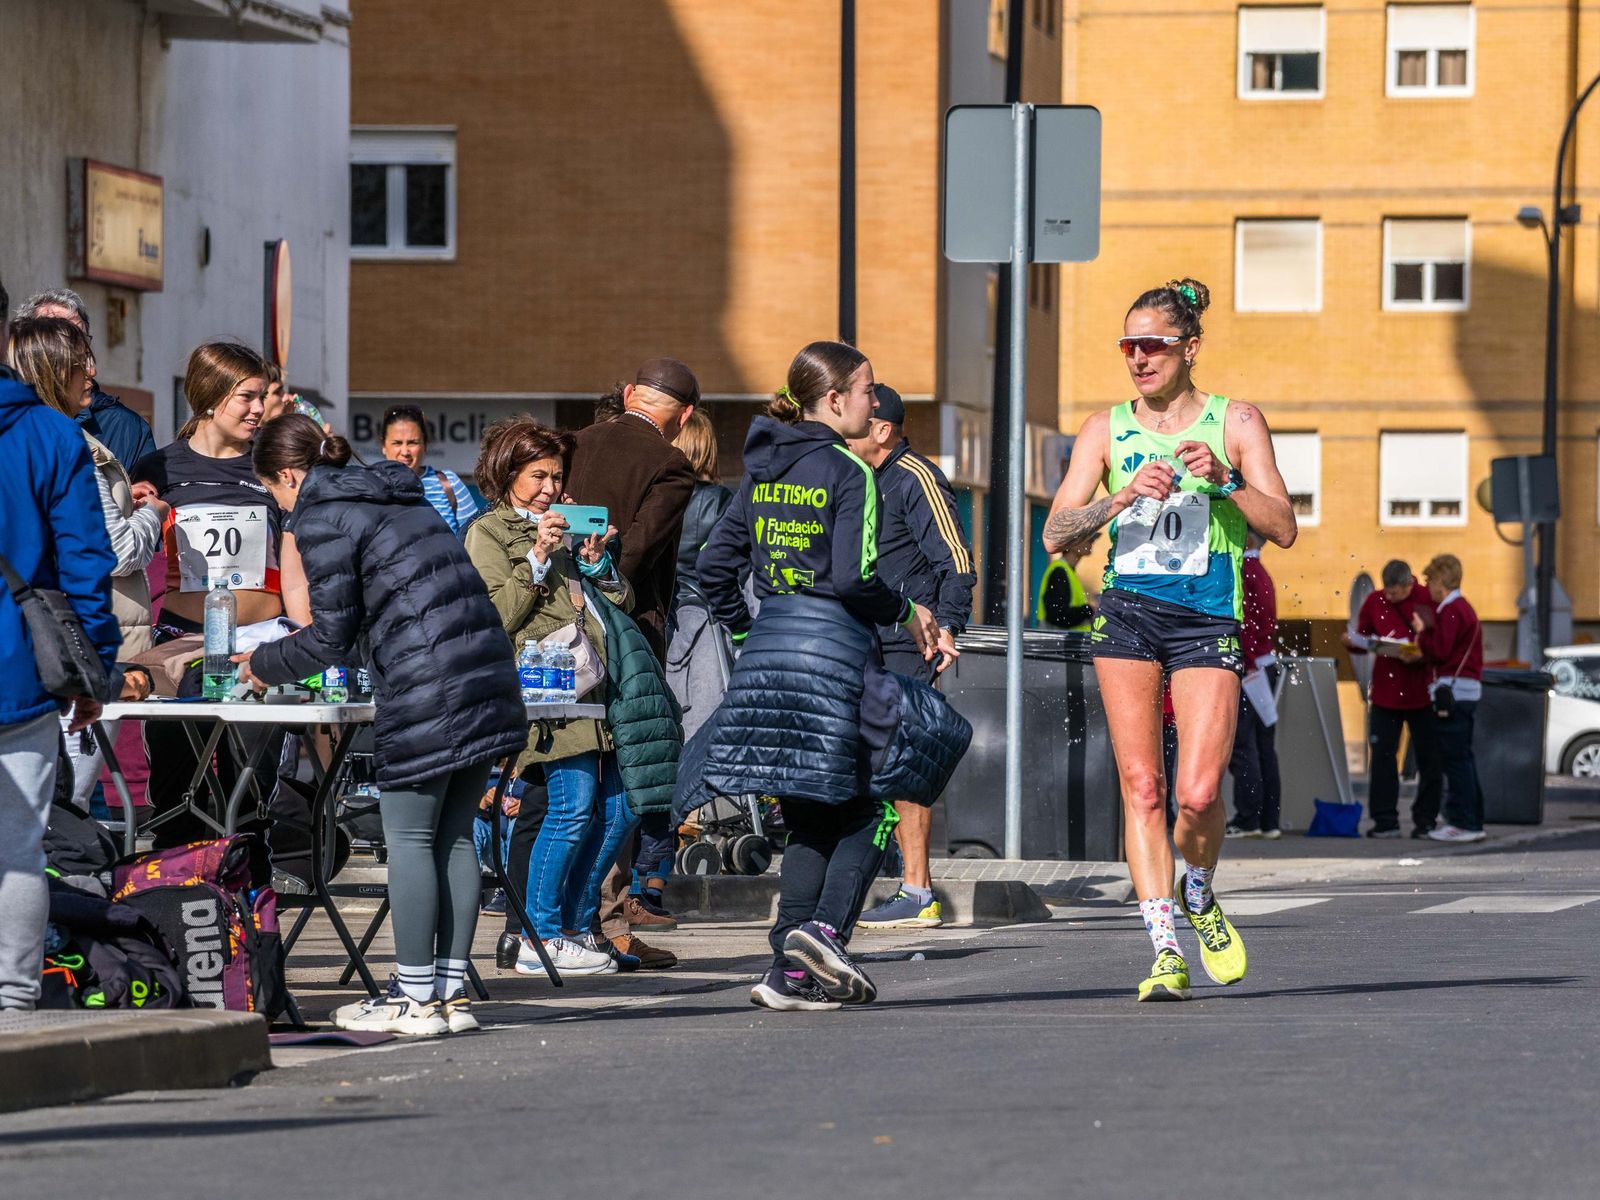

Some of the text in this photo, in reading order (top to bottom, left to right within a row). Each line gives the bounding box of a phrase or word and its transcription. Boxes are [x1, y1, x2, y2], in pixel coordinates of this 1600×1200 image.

[752, 483, 828, 508] ATLETISMO
[203, 527, 242, 557] 20
[766, 532, 811, 551] Unicaja
[181, 897, 225, 1010] arena
